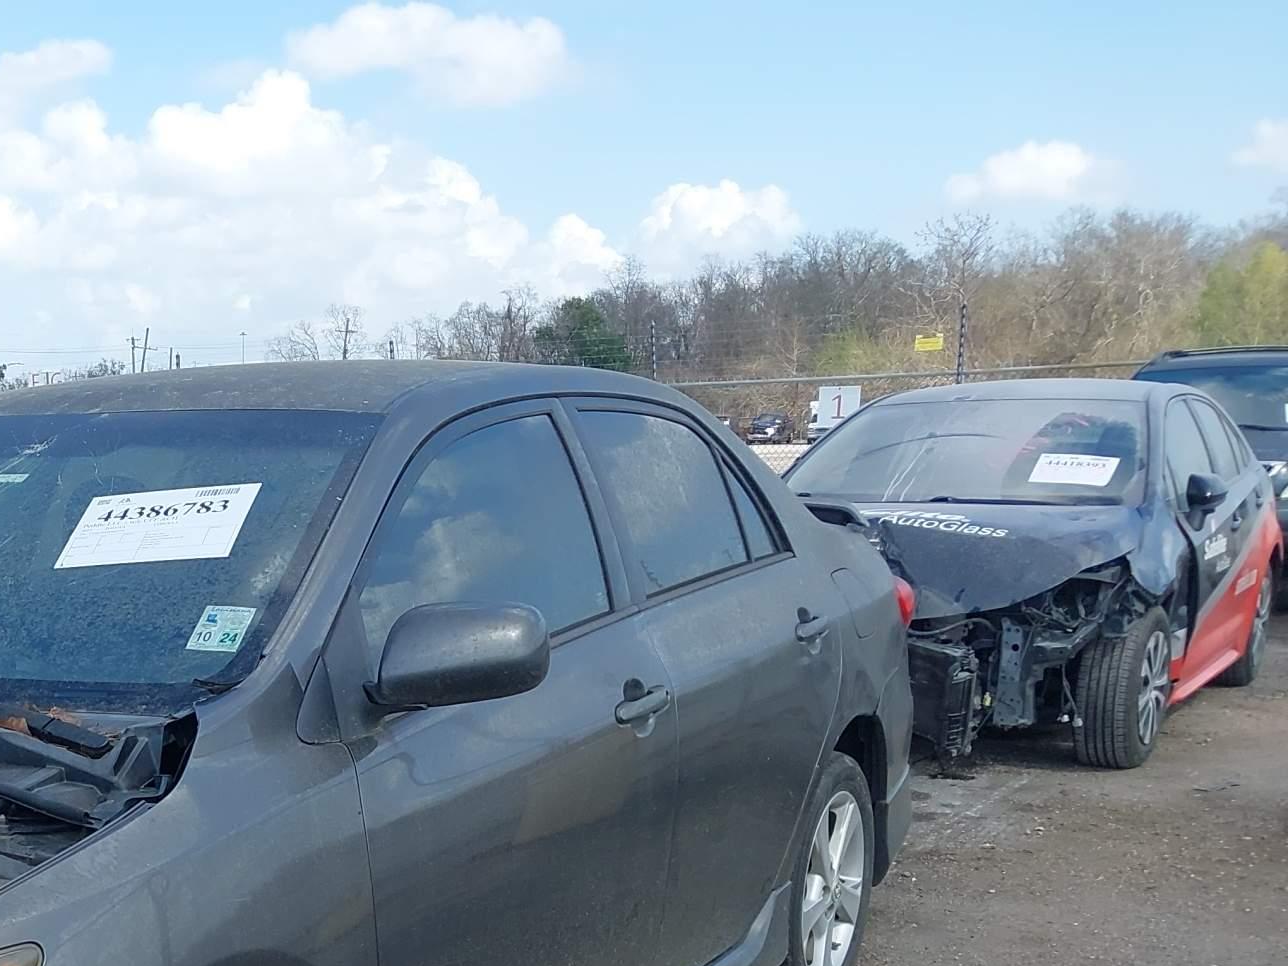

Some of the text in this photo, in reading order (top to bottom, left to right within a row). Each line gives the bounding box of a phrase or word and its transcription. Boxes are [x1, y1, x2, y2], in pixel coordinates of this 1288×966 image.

[831, 394, 846, 420] 1
[97, 499, 230, 522] 44386783
[878, 514, 1009, 537] AutoGlass
[196, 631, 239, 643] 10 24
